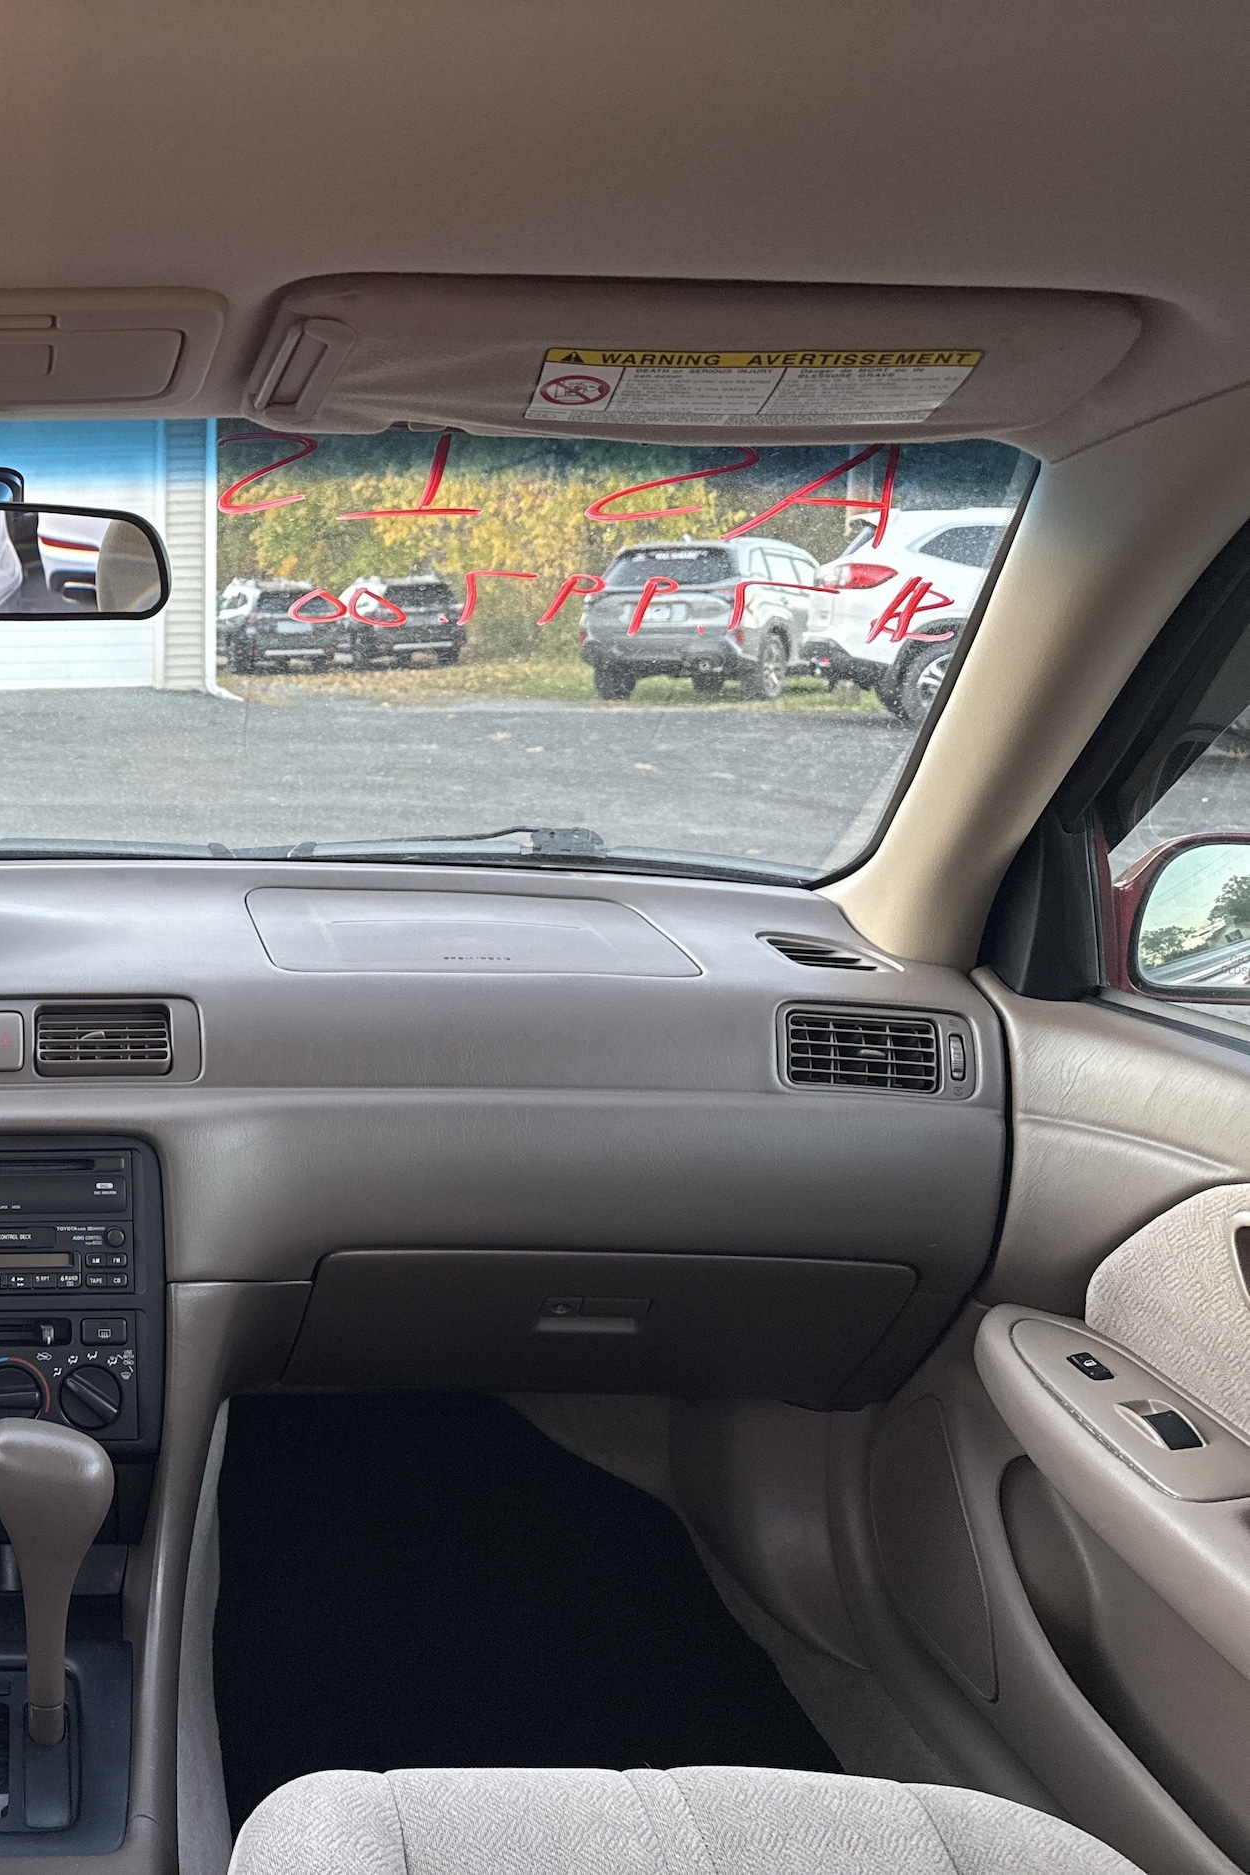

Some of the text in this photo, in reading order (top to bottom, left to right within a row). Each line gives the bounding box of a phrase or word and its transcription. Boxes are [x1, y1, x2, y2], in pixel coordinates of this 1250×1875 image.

[600, 351, 971, 366] WARNING AVERTISSEMENT
[1221, 965, 1250, 976] CLOS
